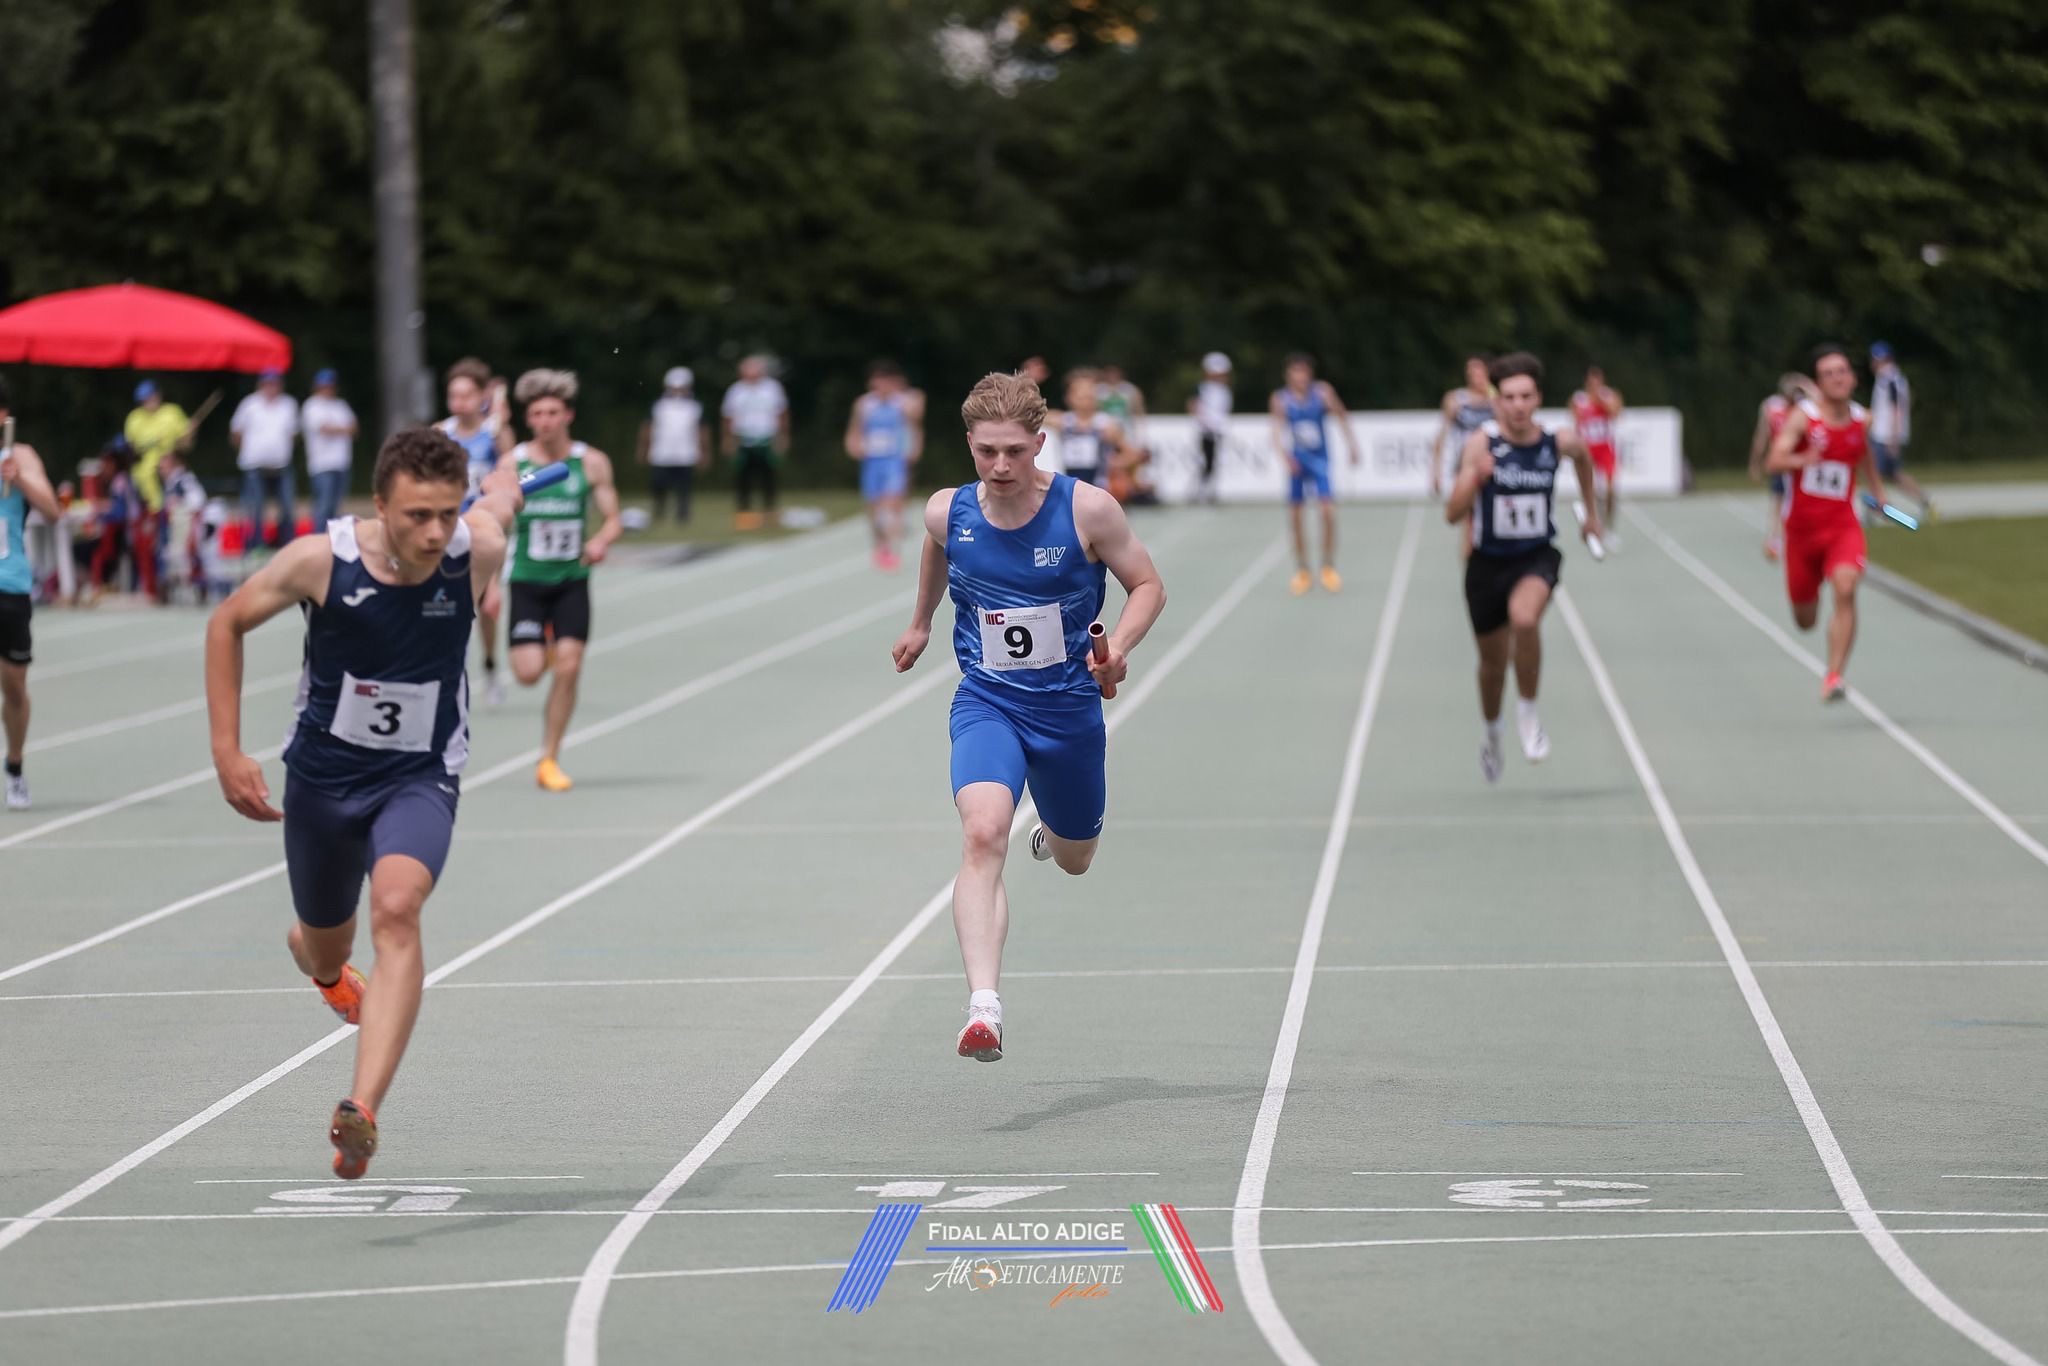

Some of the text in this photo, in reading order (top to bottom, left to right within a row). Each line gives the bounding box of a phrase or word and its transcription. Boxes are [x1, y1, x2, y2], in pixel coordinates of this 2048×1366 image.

[1033, 546, 1066, 567] BLV
[1003, 625, 1034, 659] 9
[368, 702, 402, 736] 3
